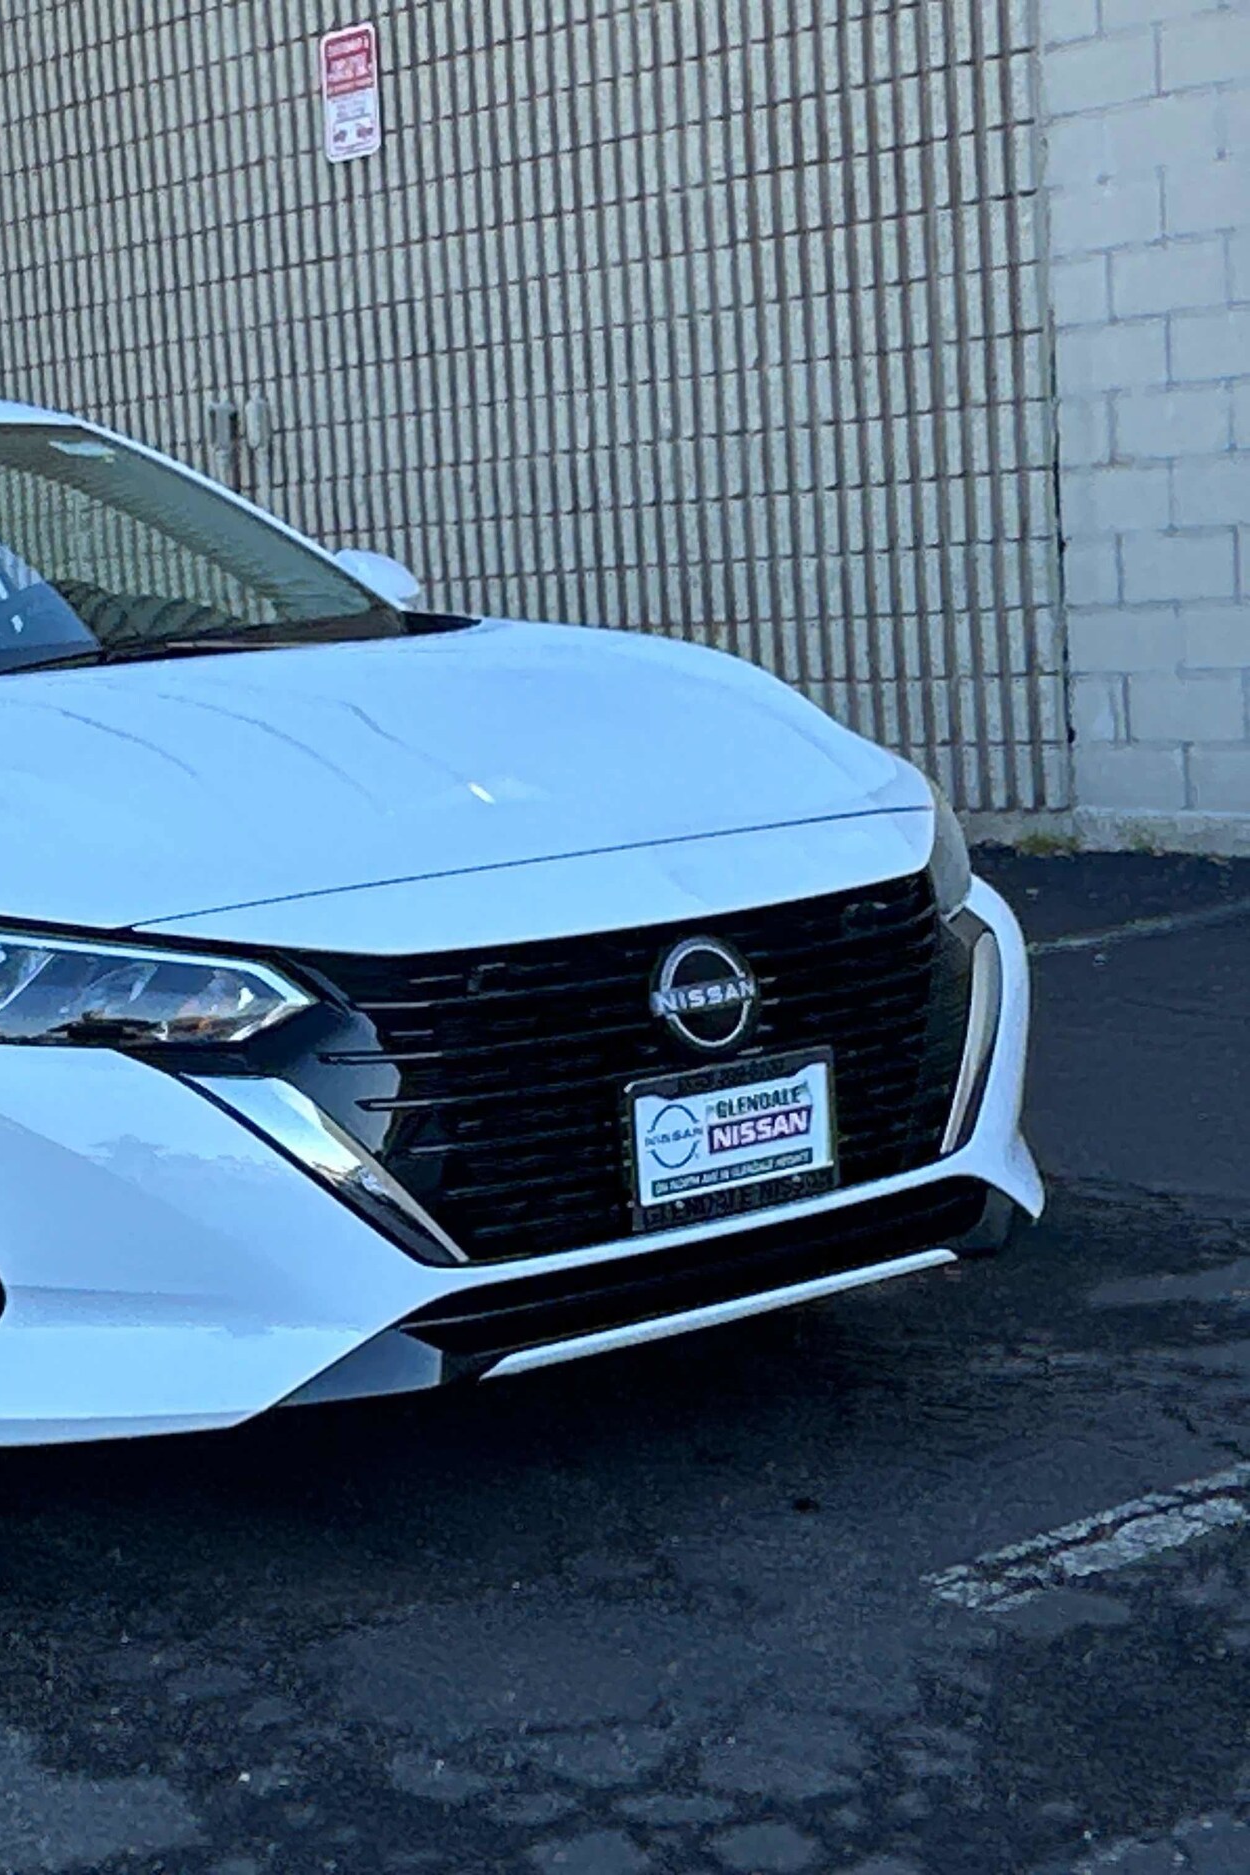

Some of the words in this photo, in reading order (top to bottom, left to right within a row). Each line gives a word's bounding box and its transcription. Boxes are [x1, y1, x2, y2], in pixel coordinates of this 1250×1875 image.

[652, 980, 754, 1013] NISSAN
[716, 1085, 801, 1119] GLENDALE
[644, 1127, 704, 1147] NISSAN
[712, 1110, 808, 1150] NISSAN
